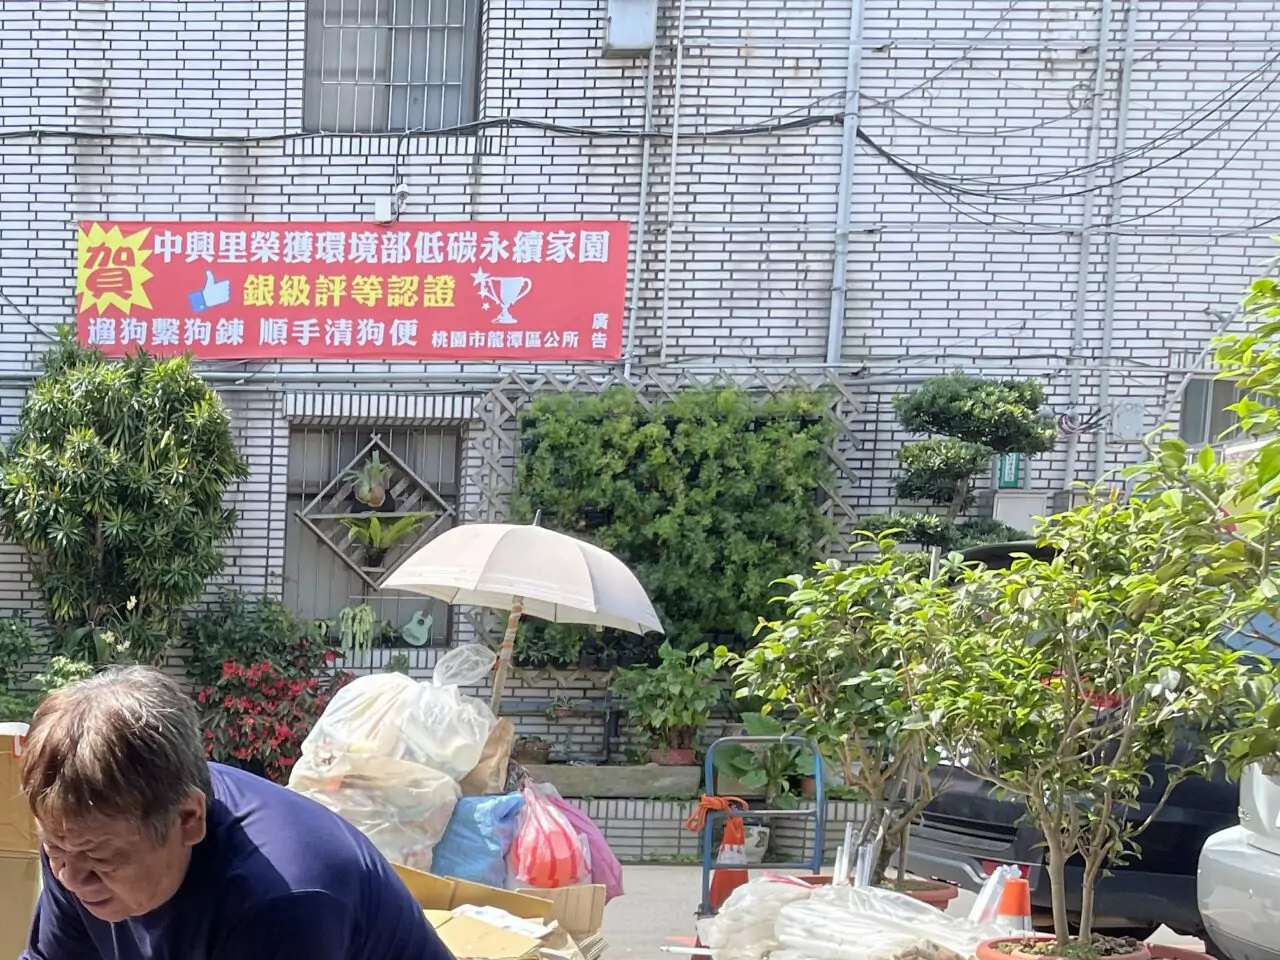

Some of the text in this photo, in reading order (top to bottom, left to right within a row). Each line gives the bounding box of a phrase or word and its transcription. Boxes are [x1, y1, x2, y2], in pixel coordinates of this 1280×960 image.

[153, 230, 610, 265] 中興里榮獲環境部低碳永續家園
[84, 243, 136, 299] 賀
[243, 274, 457, 308] 銀級評等認證
[259, 318, 419, 347] 順手清狗便
[431, 329, 580, 350] 桃園市龍潭區公所
[592, 312, 609, 349] 廣告
